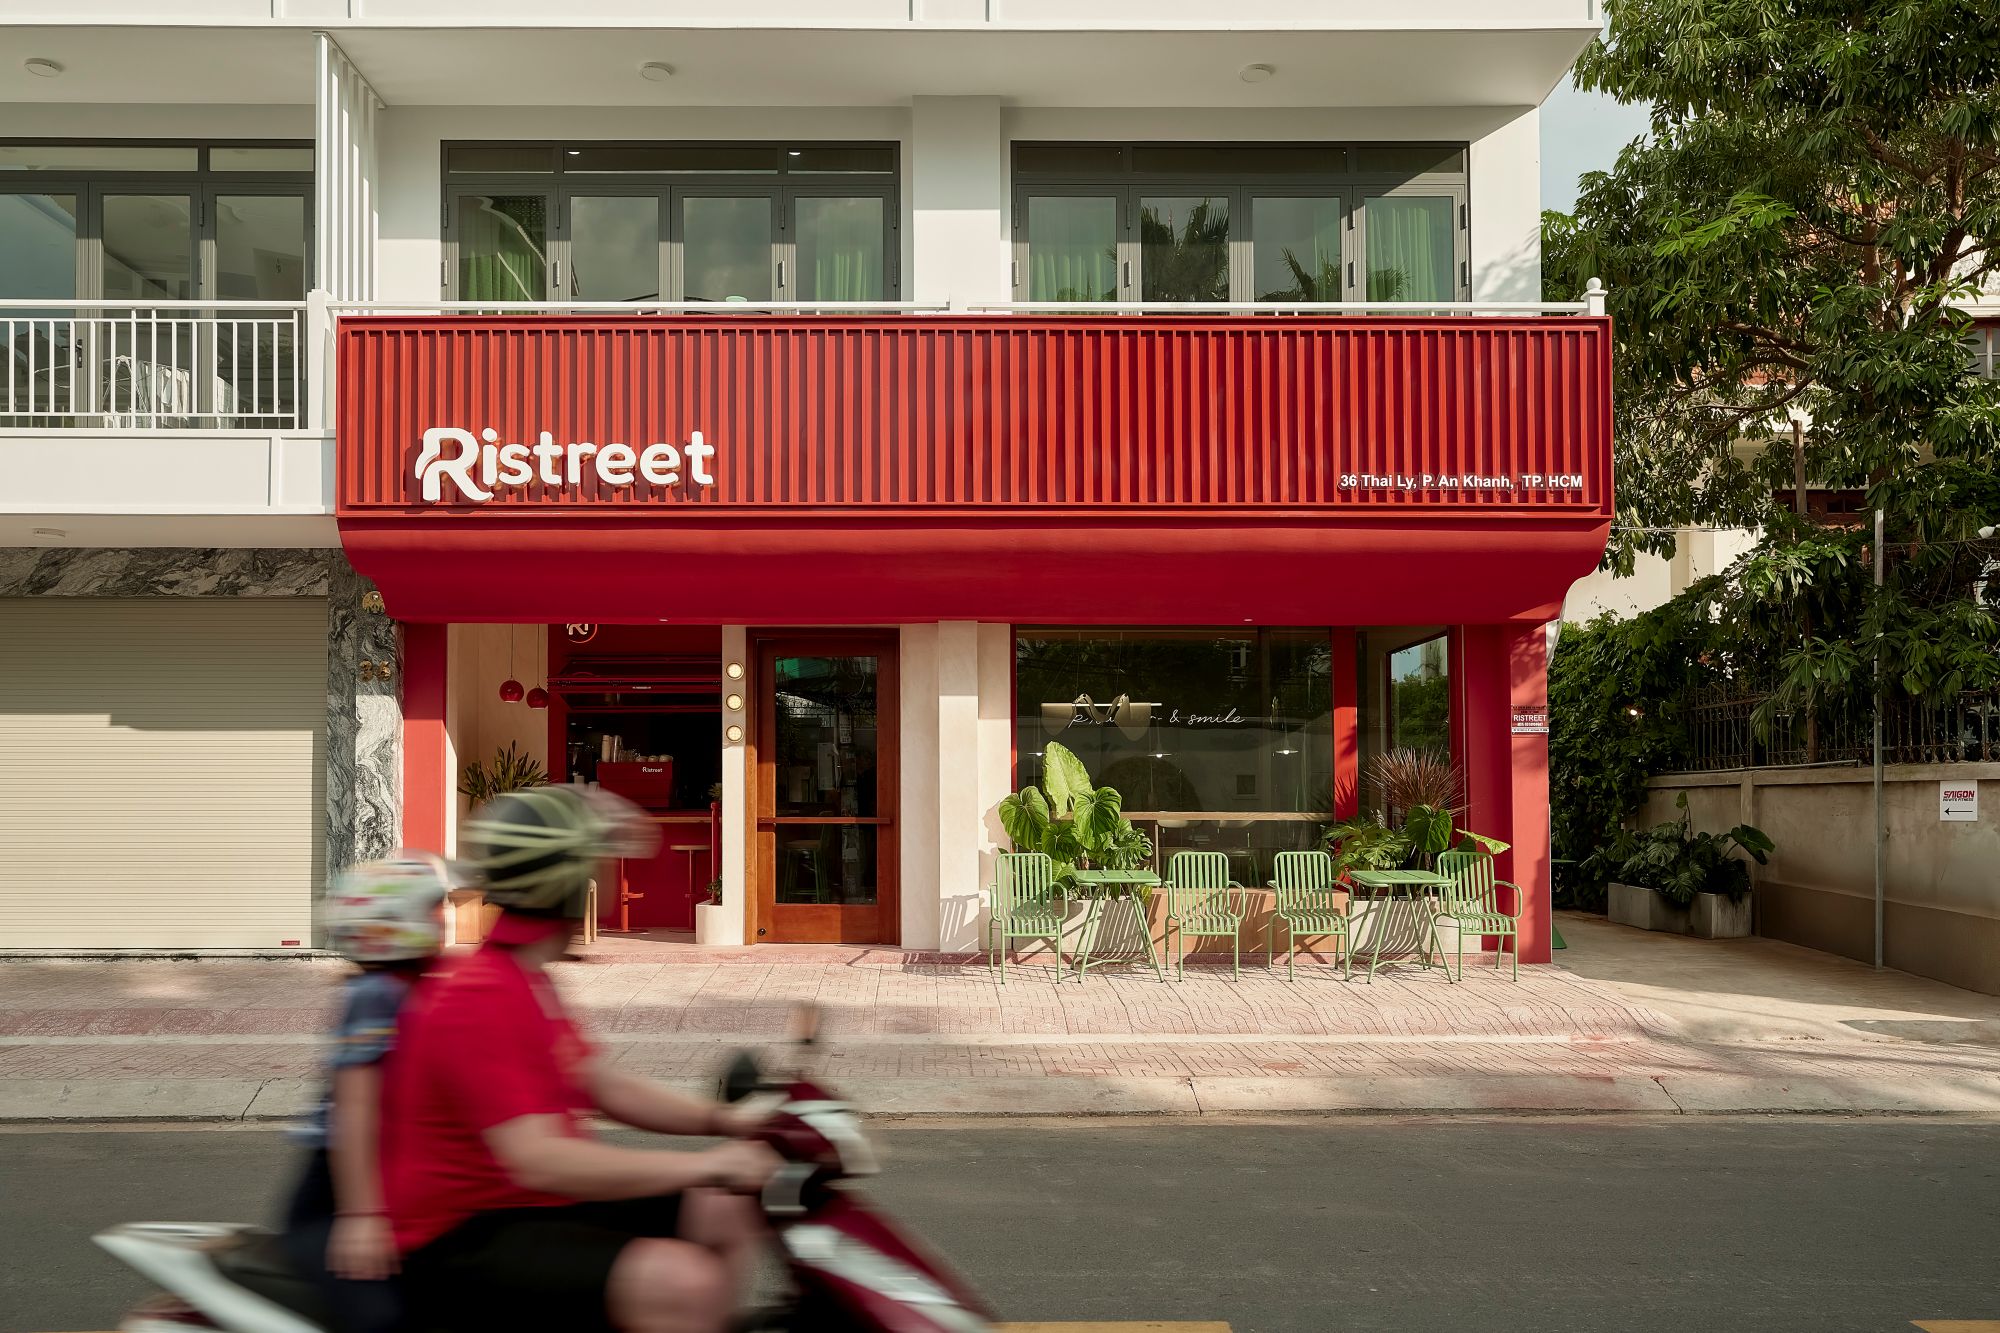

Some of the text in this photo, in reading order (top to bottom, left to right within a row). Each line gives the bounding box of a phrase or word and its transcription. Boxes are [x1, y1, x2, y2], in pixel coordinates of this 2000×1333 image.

[415, 427, 715, 501] Ristreet
[1340, 474, 1583, 490] 36 Thai Ly, P. An Khanh, TP. HCM
[1187, 707, 1246, 725] smile
